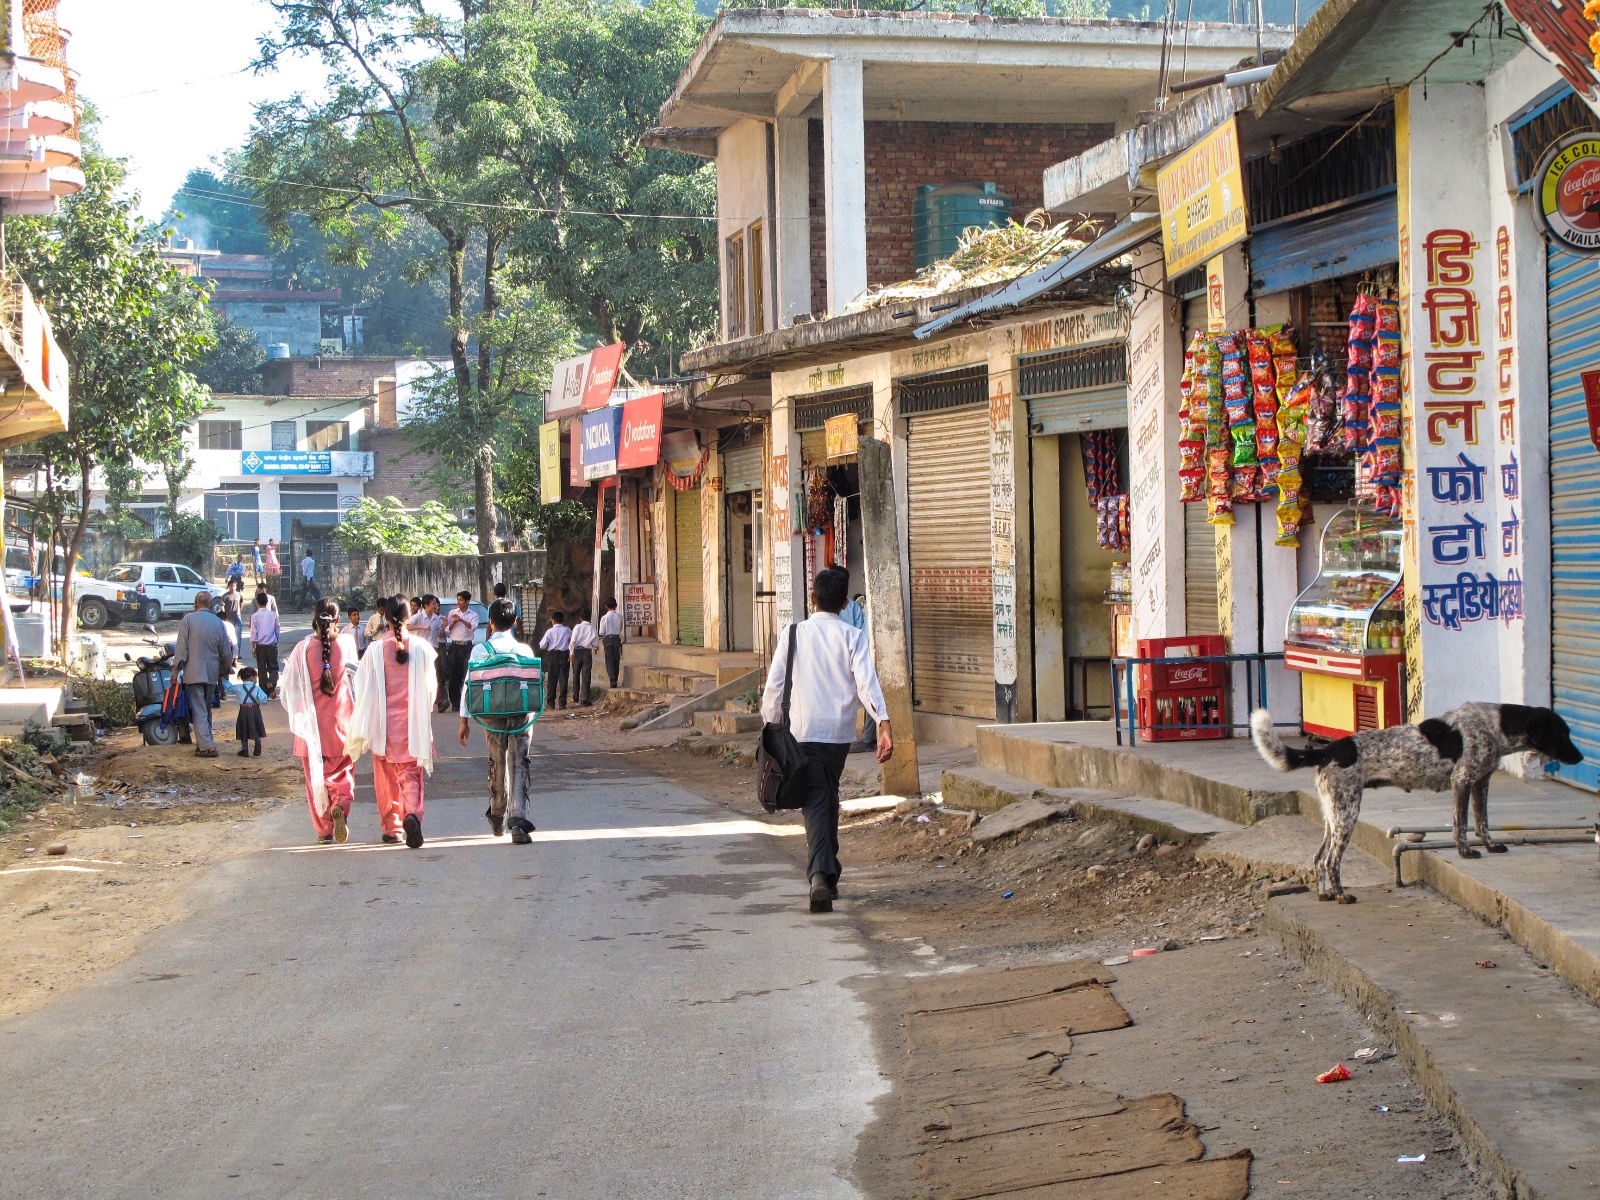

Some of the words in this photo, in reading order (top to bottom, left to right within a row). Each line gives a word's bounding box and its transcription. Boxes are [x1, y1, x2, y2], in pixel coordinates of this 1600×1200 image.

[1550, 153, 1569, 176] ICE
[1572, 143, 1600, 158] COL
[1158, 166, 1181, 218] VIJAY
[1181, 145, 1212, 204] BAKERY
[1212, 126, 1235, 182] UNIT
[1053, 313, 1085, 347] SPORTS
[1422, 228, 1485, 446] डिजिटल
[585, 422, 611, 451] NOKIA
[631, 420, 656, 442] vodafone
[1284, 457, 1297, 465] CHIPS
[1284, 490, 1297, 498] CHIPS
[1426, 451, 1488, 566] फोटो
[1282, 522, 1296, 531] CHIPS
[626, 603, 651, 611] PCO
[626, 610, 652, 618] STD
[1175, 667, 1207, 680] Coca-Cola
